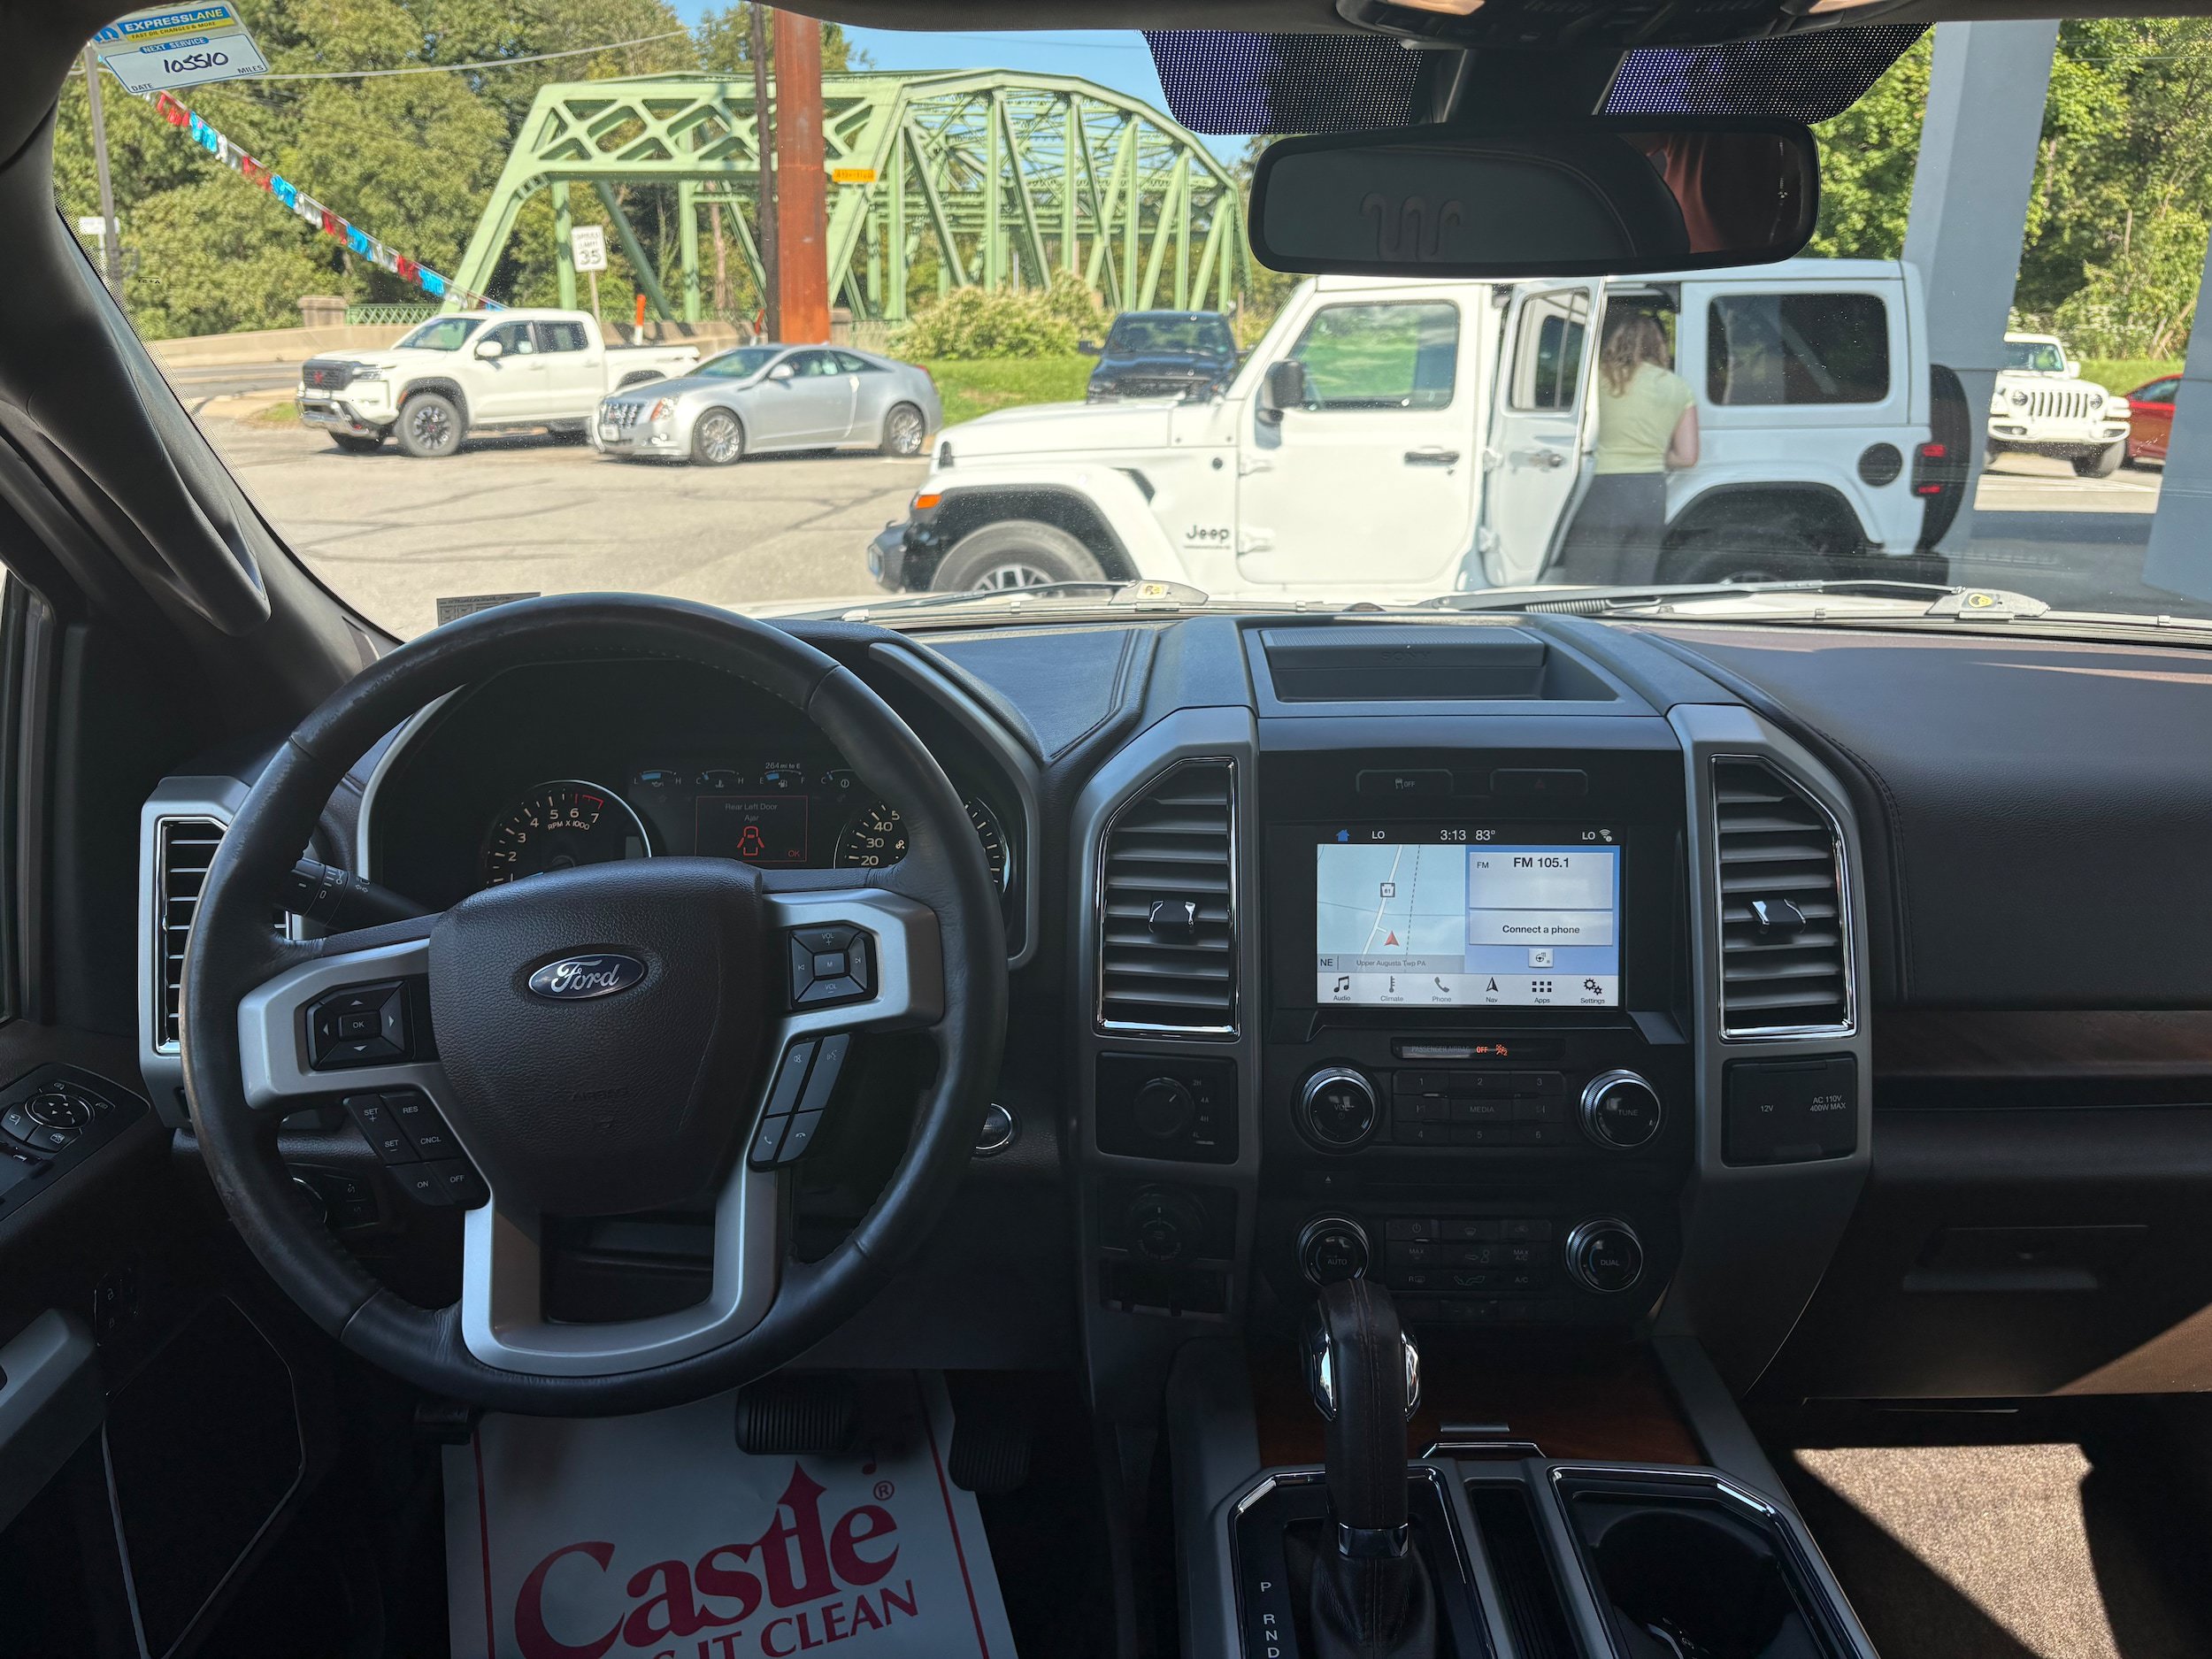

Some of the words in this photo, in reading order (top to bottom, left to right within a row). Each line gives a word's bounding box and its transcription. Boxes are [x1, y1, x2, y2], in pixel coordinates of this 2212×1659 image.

[125, 9, 223, 32] EXPRESSLANE
[159, 25, 190, 35] CHANGES
[142, 44, 165, 53] NEXT
[170, 37, 205, 50] SERVICE
[164, 52, 228, 73] 105510
[237, 65, 264, 74] MILES
[131, 82, 153, 92] DATE
[580, 250, 602, 265] 35
[1186, 525, 1230, 543] Jeep
[550, 810, 558, 819] 5
[570, 808, 579, 818] 6
[591, 813, 599, 823] 7
[530, 818, 539, 827] 4
[547, 820, 563, 830] RPM
[572, 820, 590, 830] 1000
[873, 821, 893, 832] 40
[518, 833, 526, 842] 3
[1371, 830, 1385, 840] LO
[1440, 829, 1466, 841] 3:13
[1582, 830, 1595, 840] LO
[866, 838, 884, 849] 30
[508, 851, 517, 861] 2
[861, 856, 879, 866] 20
[1513, 857, 1533, 868] FM
[1537, 857, 1570, 868] 105.1
[1502, 925, 1541, 934] Connect
[1549, 925, 1579, 935] phone
[1376, 959, 1402, 968] Augusta
[551, 959, 619, 993] Ford
[1534, 996, 1550, 1005] Apps
[364, 1107, 379, 1117] SET
[384, 1139, 399, 1148] SET
[420, 1136, 442, 1145] CNCL
[449, 1174, 465, 1183] OFF
[515, 1461, 900, 1659] Castle
[1260, 1581, 1272, 1593] P
[760, 1579, 918, 1658] CLEAN
[1263, 1613, 1276, 1624] R
[1265, 1629, 1279, 1641] N
[1267, 1647, 1280, 1658] D
